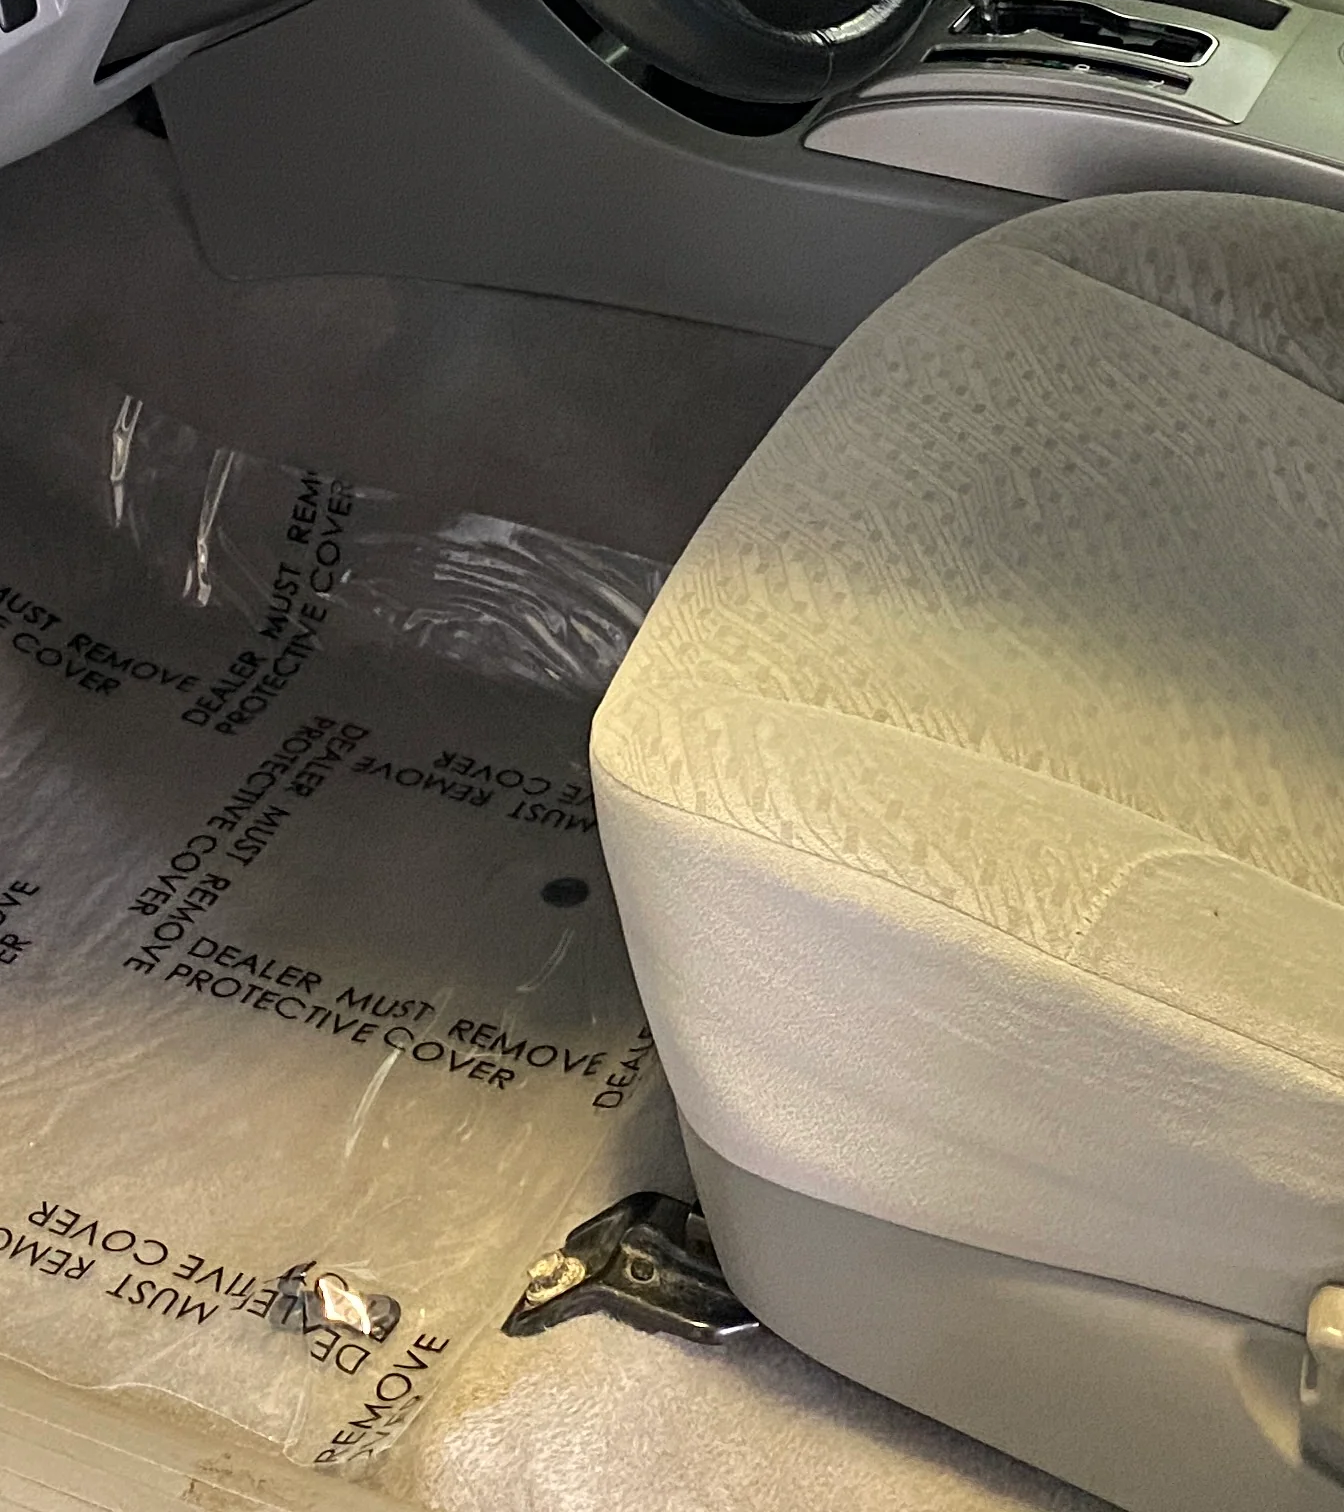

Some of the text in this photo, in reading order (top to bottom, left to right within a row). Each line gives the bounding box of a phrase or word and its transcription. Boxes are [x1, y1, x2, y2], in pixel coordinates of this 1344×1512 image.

[12, 632, 122, 696] COVER
[66, 632, 199, 693] REMOVE
[181, 650, 269, 727] DEALER
[258, 561, 301, 640] MUST
[214, 479, 354, 737] PROTECTIVE COVER
[127, 715, 337, 917] PROTECTIVE COVER
[350, 755, 598, 833] MUST REMOVE
[432, 750, 552, 796] COVER
[122, 722, 373, 975] DEALER MUST REMOVE
[164, 963, 516, 1090] PROTECTIVE COVER
[187, 935, 609, 1077] DEALER MUST REMOVE
[27, 1200, 169, 1266] COVER
[104, 1274, 220, 1325] MUST
[313, 1333, 450, 1465] REMOVE
